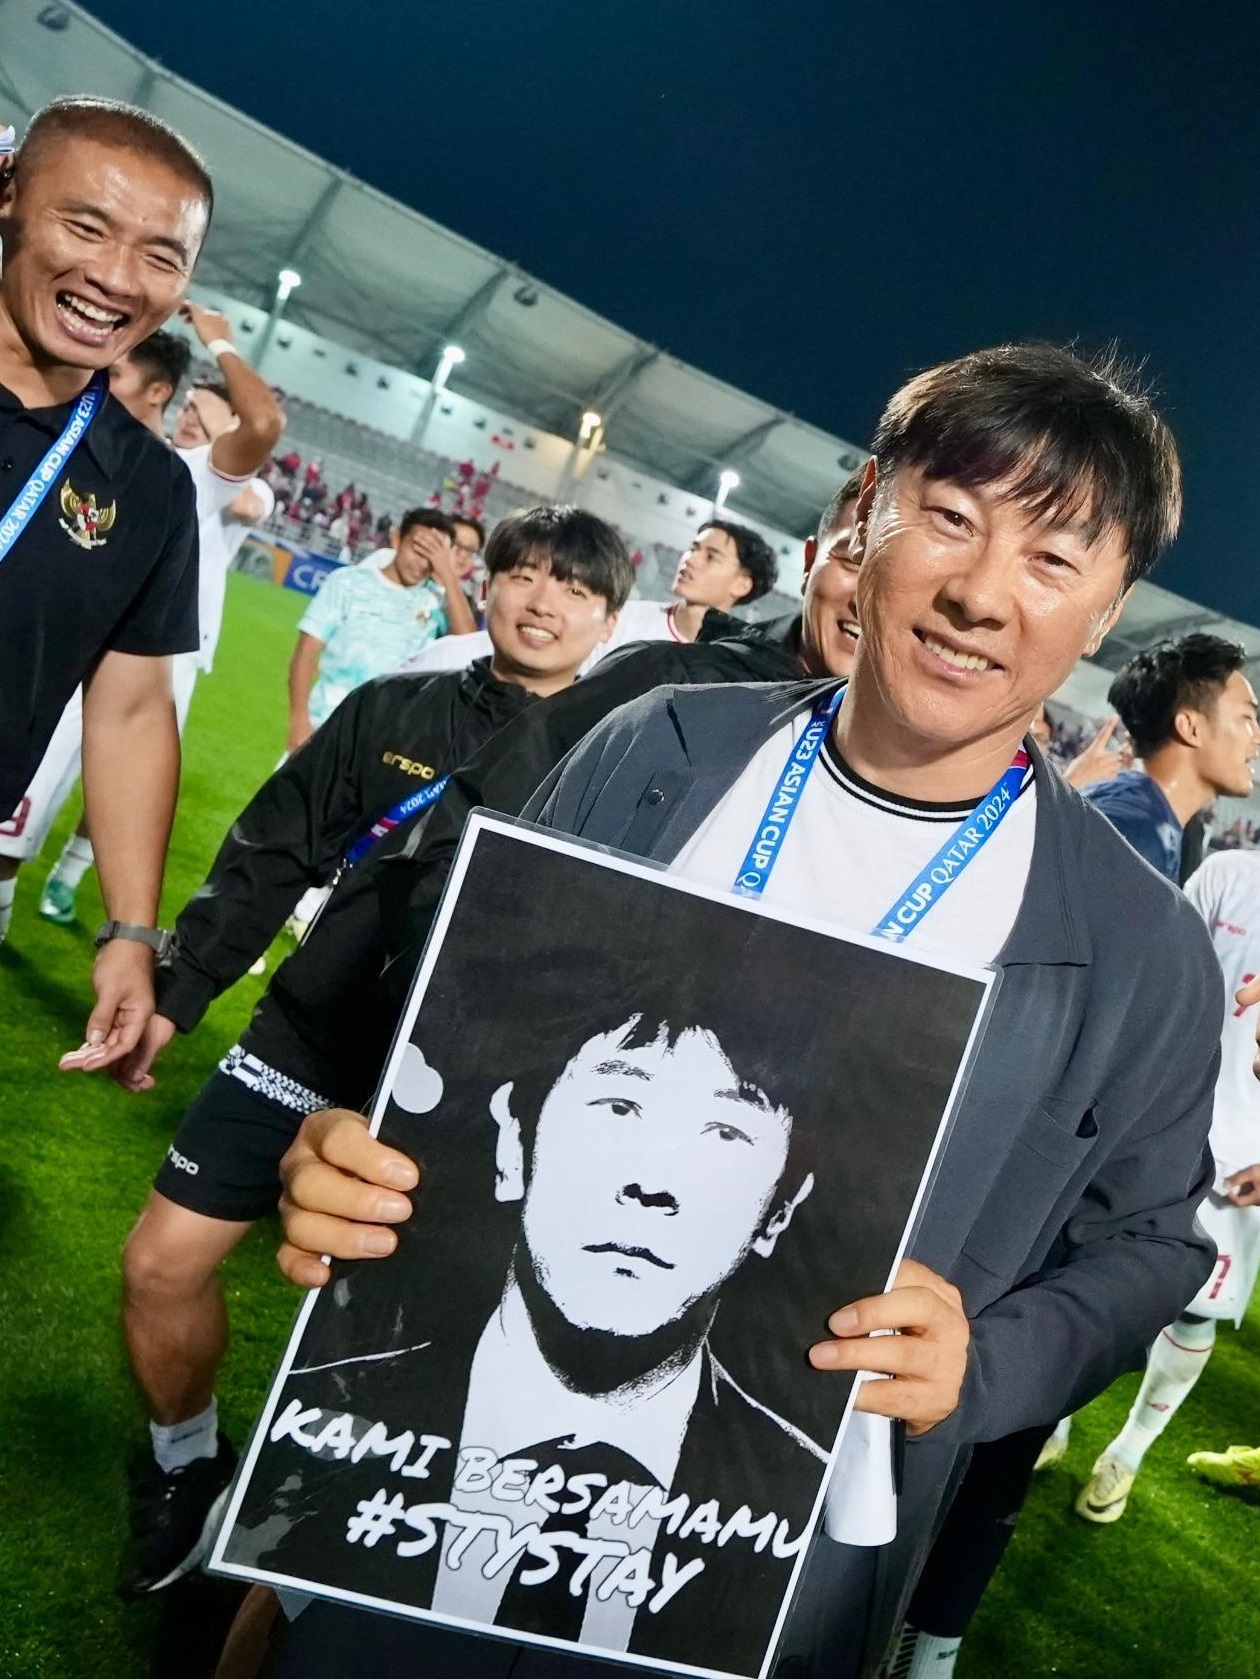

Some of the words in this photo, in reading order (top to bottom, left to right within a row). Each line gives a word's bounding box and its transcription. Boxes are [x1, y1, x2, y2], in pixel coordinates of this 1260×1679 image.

[40, 454, 62, 483] CUP
[13, 480, 45, 521] QATAR
[795, 727, 823, 761] U23
[382, 751, 436, 780] erspo
[768, 761, 806, 824] ASIAN
[752, 826, 781, 869] CUP
[896, 882, 932, 924] CUP
[930, 826, 985, 885] QATAR
[976, 786, 1011, 831] 2024
[168, 1143, 200, 1175] rspo
[270, 1398, 451, 1479] KAMI
[452, 1446, 806, 1559] BERSAMAMU
[345, 1488, 705, 1614] #STYSTAY
